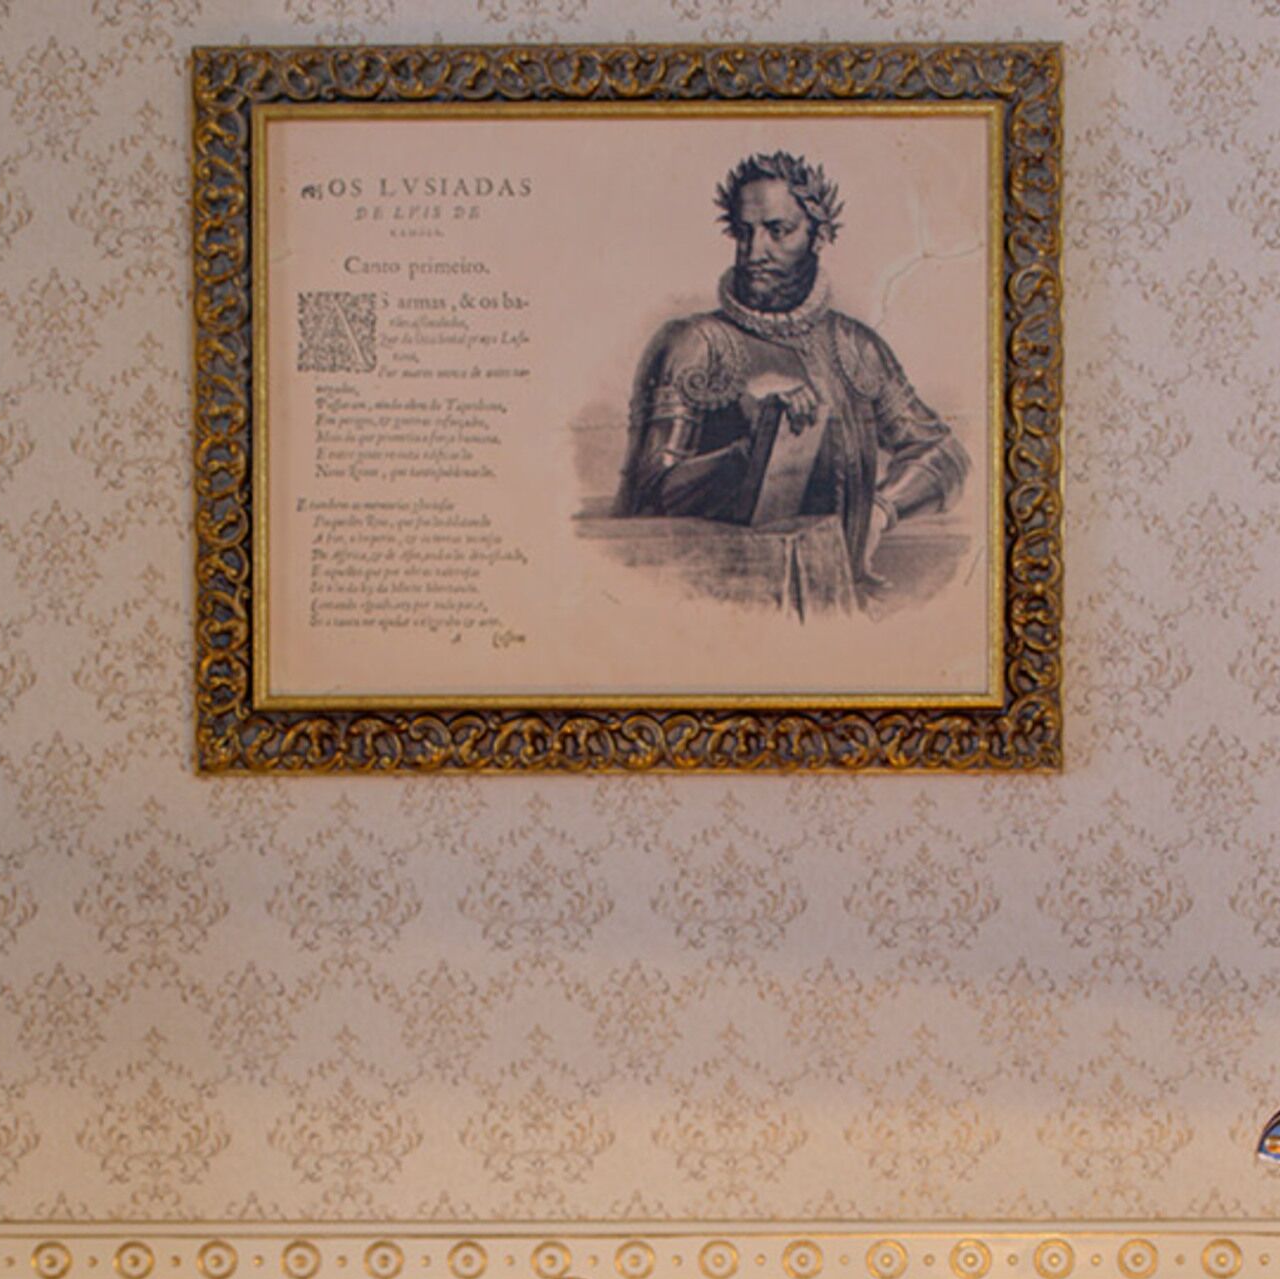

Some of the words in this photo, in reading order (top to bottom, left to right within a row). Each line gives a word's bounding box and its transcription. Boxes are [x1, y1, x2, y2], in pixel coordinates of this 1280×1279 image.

[327, 177, 363, 198] OS
[379, 177, 532, 198] LVSIADAS
[343, 255, 401, 275] Canto
